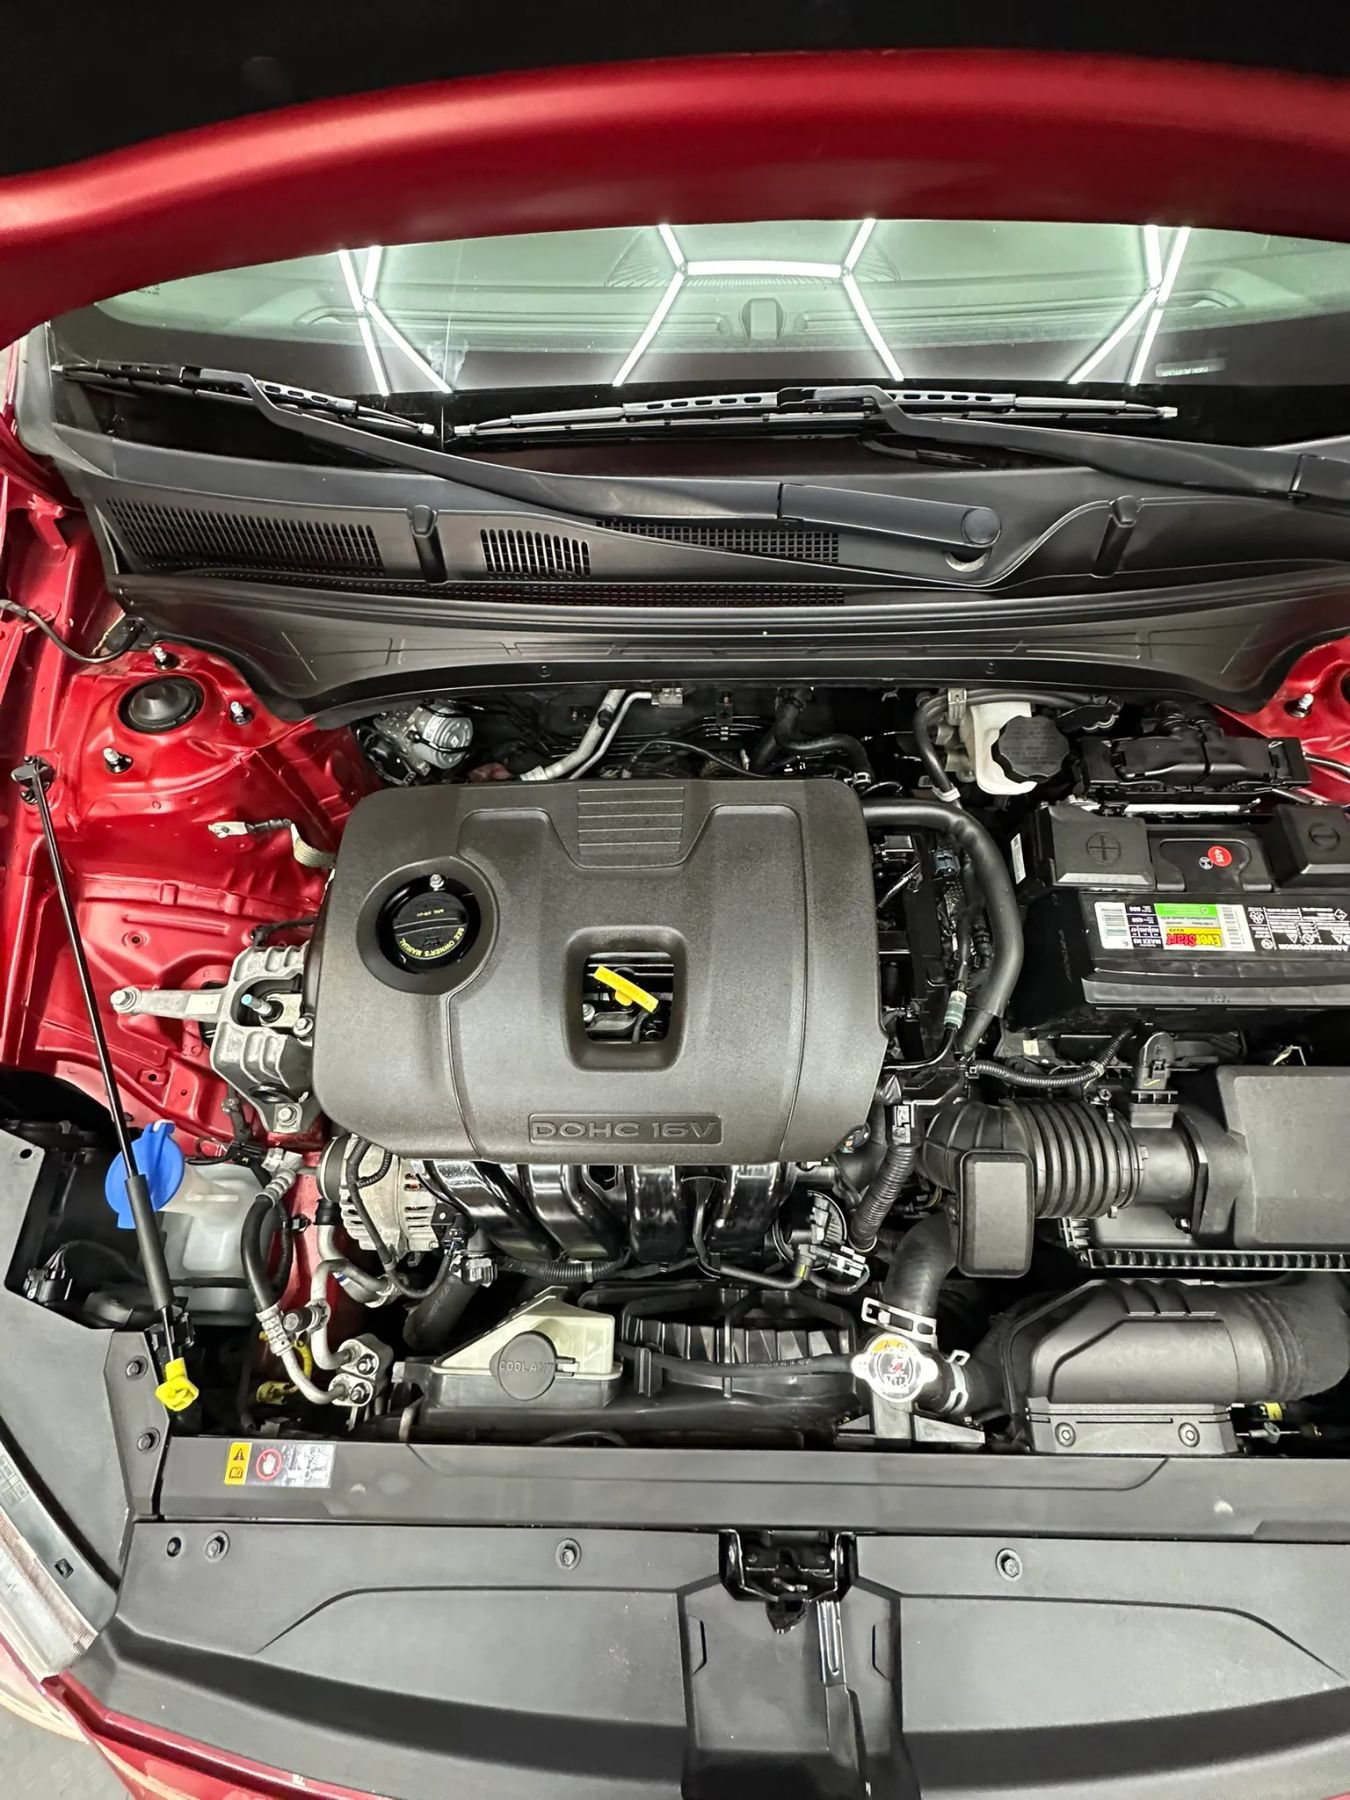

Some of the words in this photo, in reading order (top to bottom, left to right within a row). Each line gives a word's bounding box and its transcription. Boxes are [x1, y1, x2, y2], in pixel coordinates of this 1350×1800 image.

[453, 927, 465, 941] SEE
[1166, 933, 1222, 948] EverStart
[399, 937, 423, 957] MANUAL
[424, 940, 455, 957] OWNER'S
[532, 1122, 640, 1138] DOHC
[652, 1122, 717, 1138] 16V
